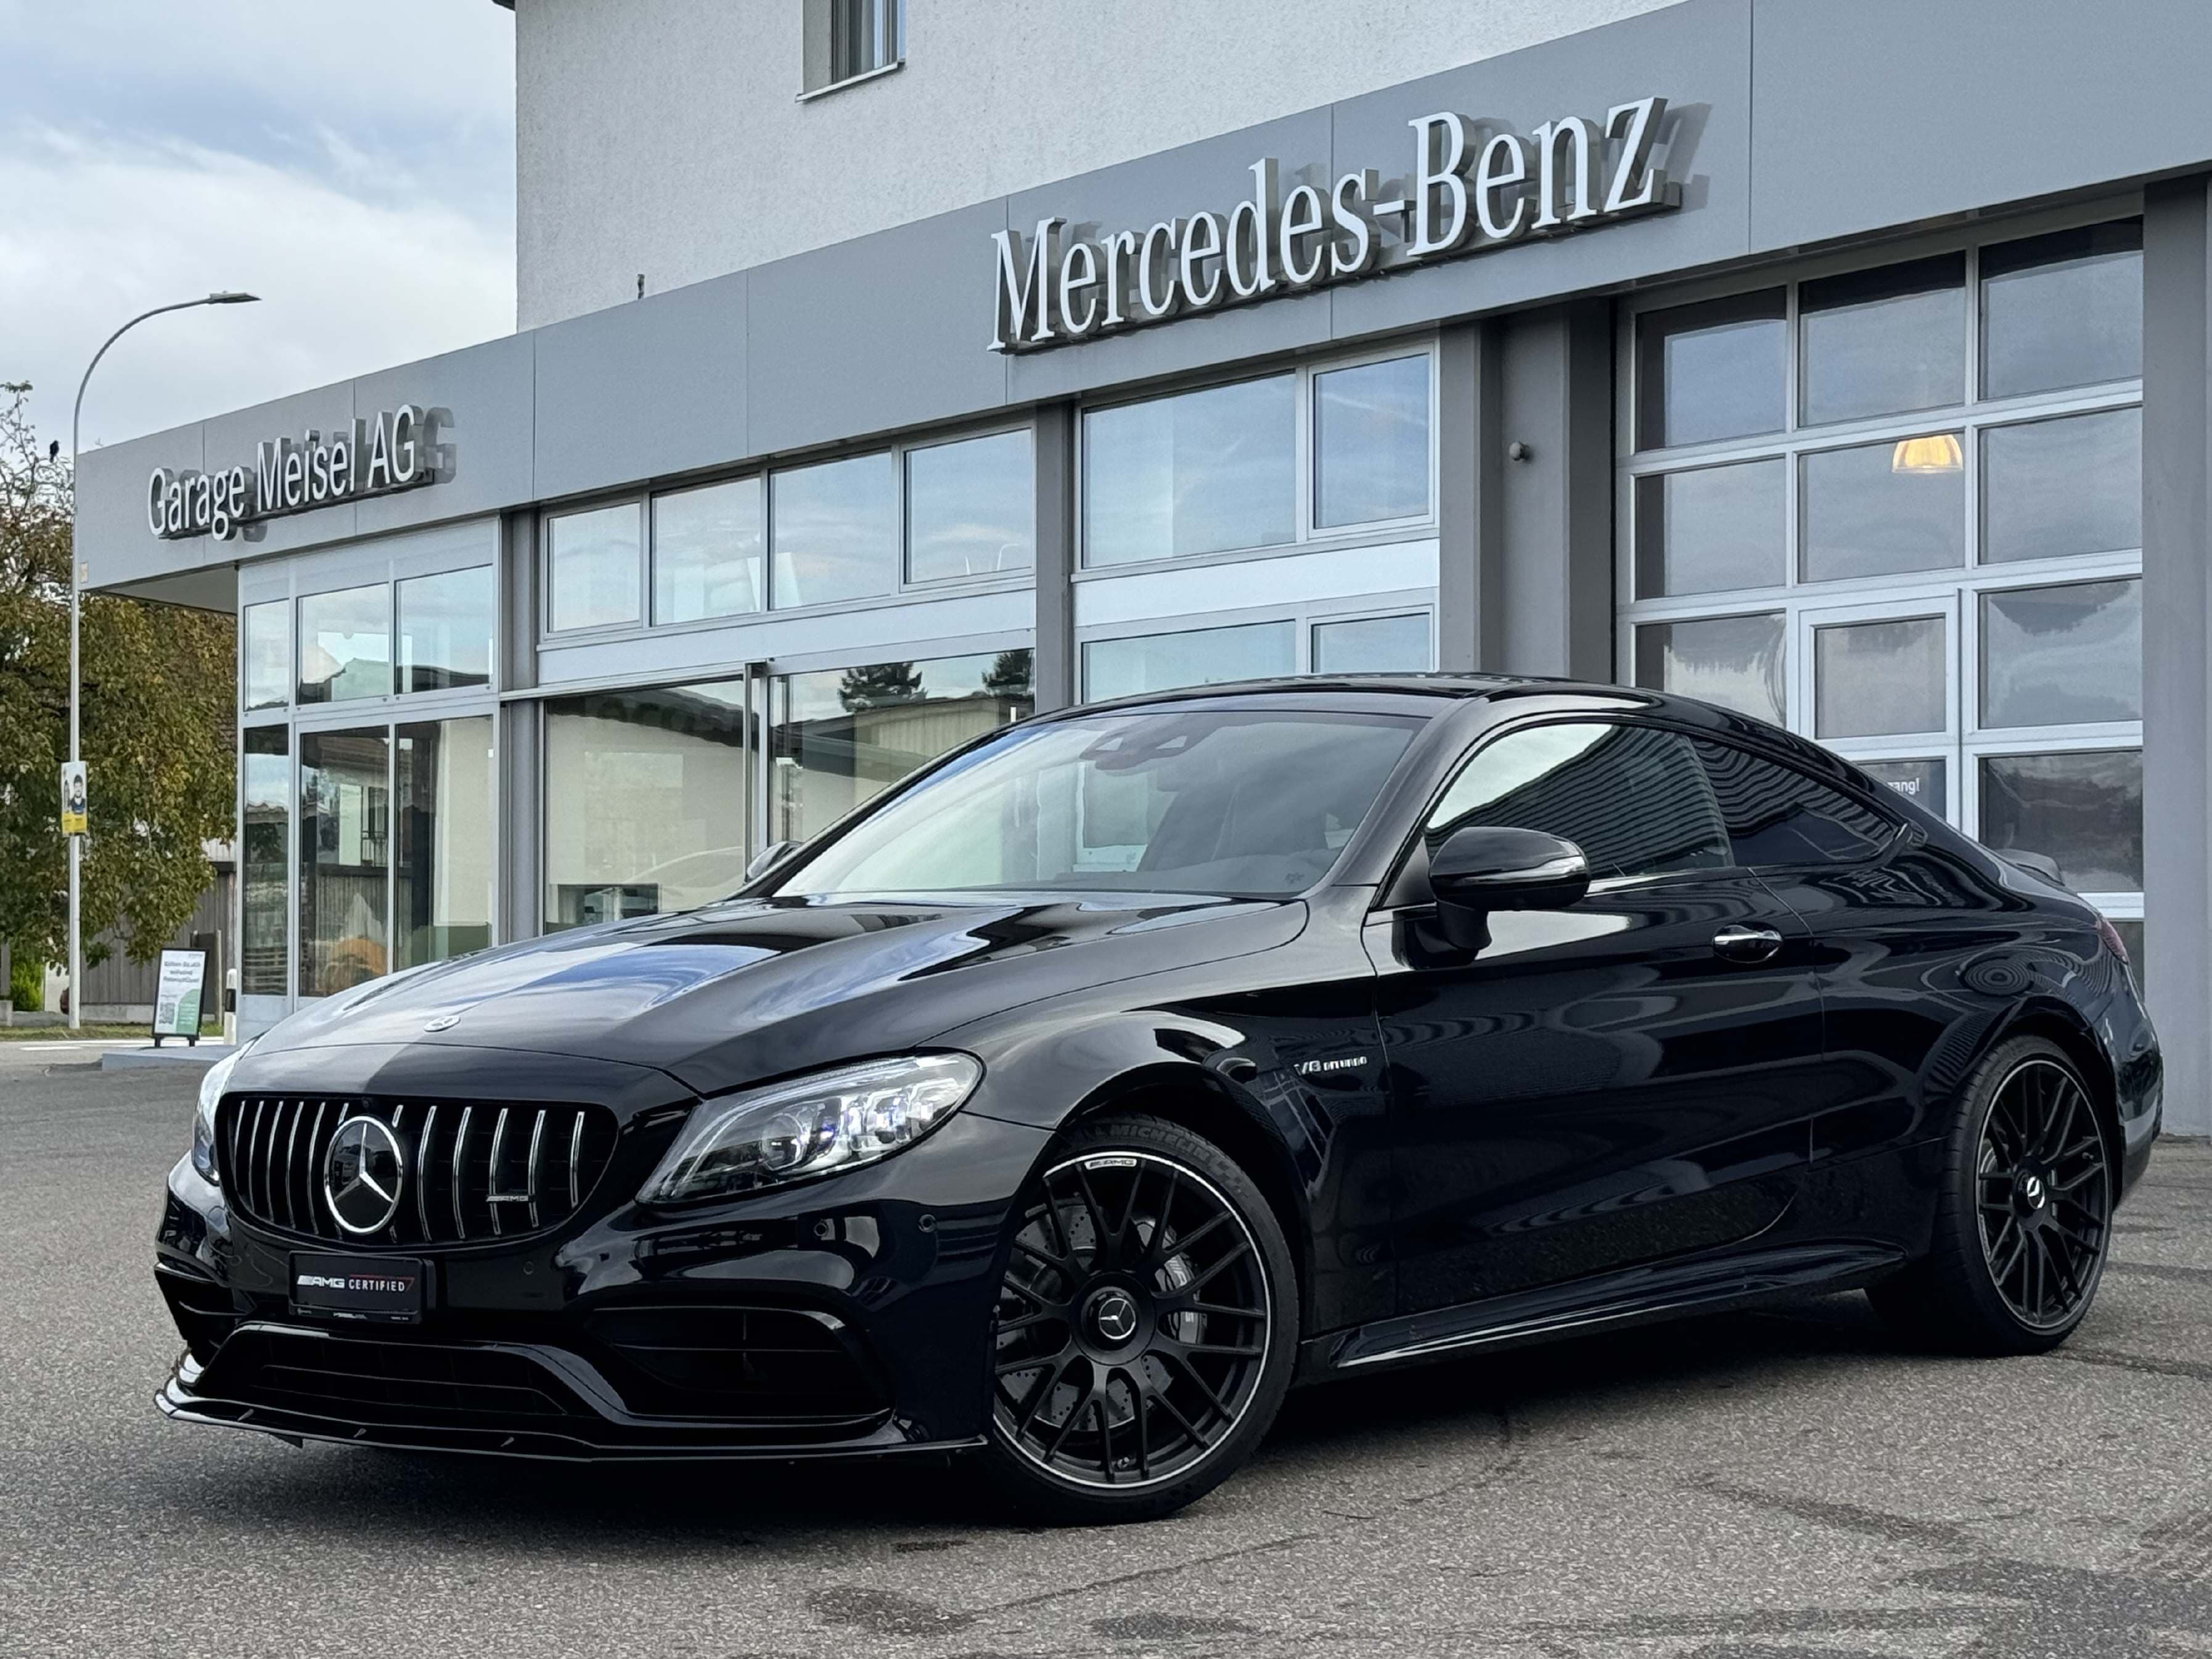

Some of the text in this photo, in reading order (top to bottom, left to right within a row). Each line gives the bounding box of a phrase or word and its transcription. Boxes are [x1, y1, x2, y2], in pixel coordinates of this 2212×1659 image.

[986, 96, 1657, 351] Mercedes-Benz
[148, 404, 415, 541] Garage Meisel AG
[310, 1276, 406, 1292] AMG CERTIFIED
